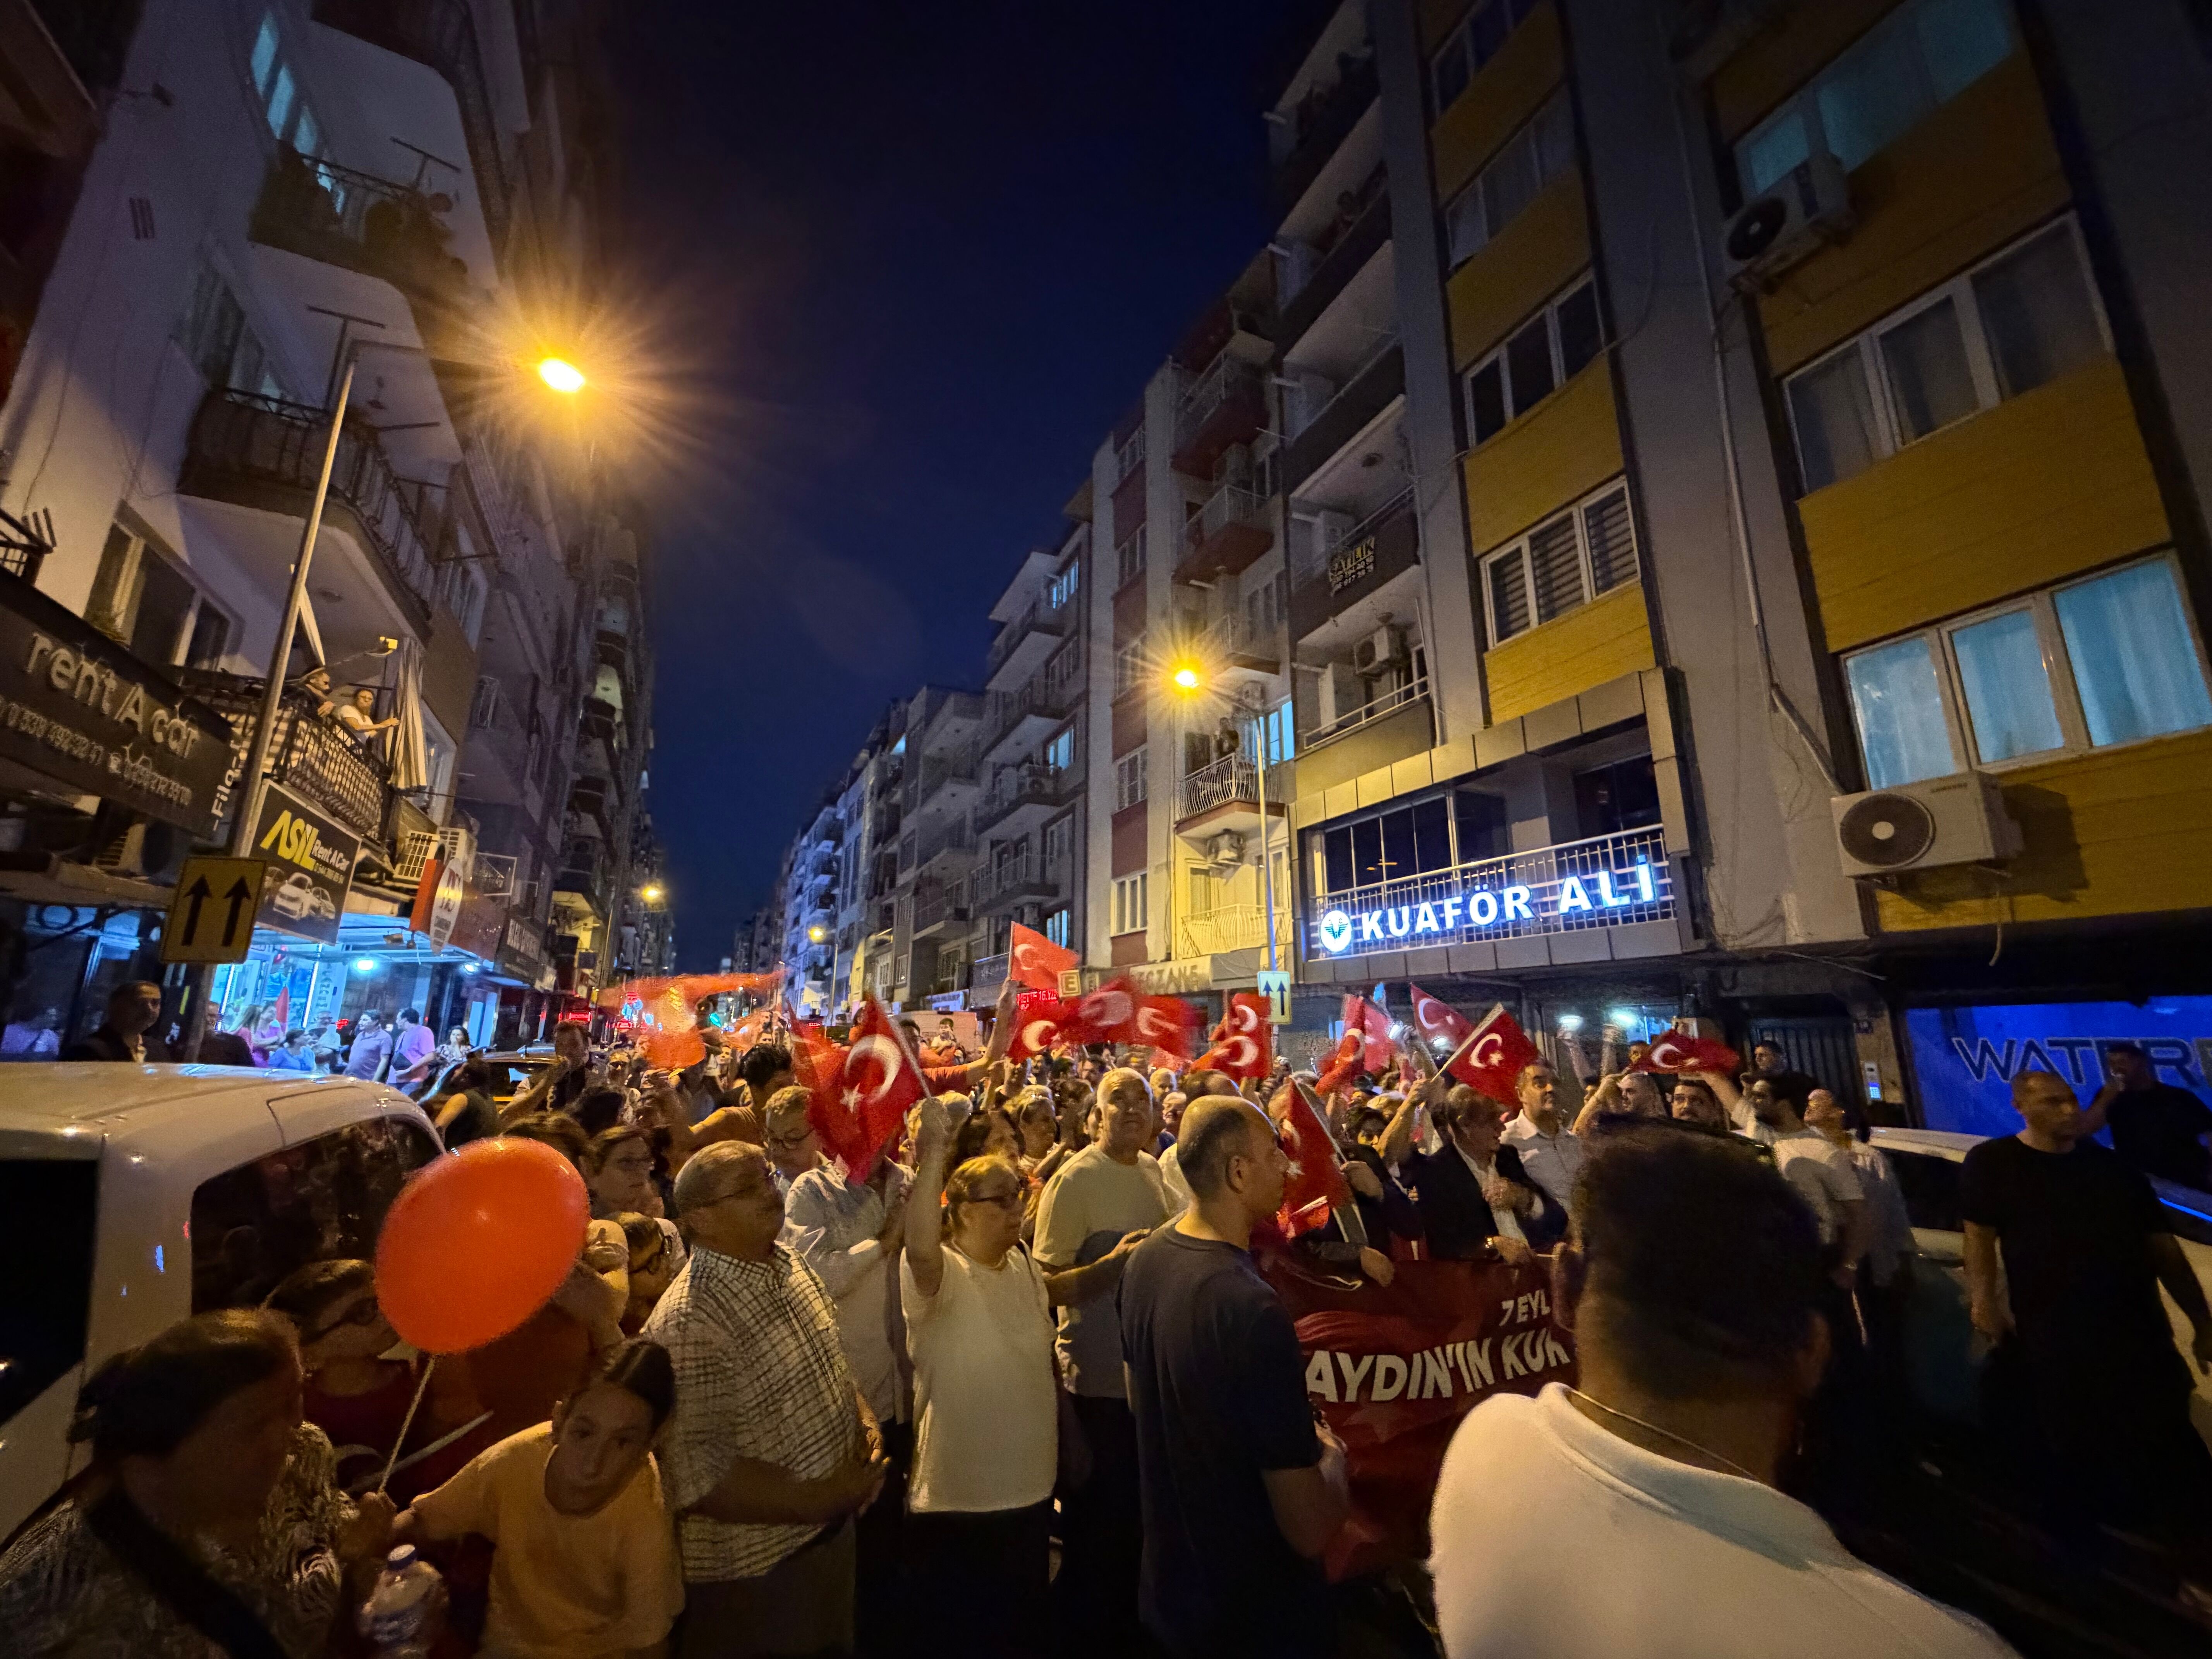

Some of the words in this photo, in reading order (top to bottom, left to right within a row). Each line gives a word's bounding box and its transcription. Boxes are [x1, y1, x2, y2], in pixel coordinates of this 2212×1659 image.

[26, 632, 117, 714] rent
[117, 683, 144, 734] A
[153, 709, 199, 758] car
[312, 840, 332, 863] Rent
[1361, 883, 1537, 941] KUAFÖR
[1558, 854, 1656, 915] ALİ
[1499, 1300, 1515, 1326] 7
[1305, 1337, 1495, 1403] AYDIN'IN
